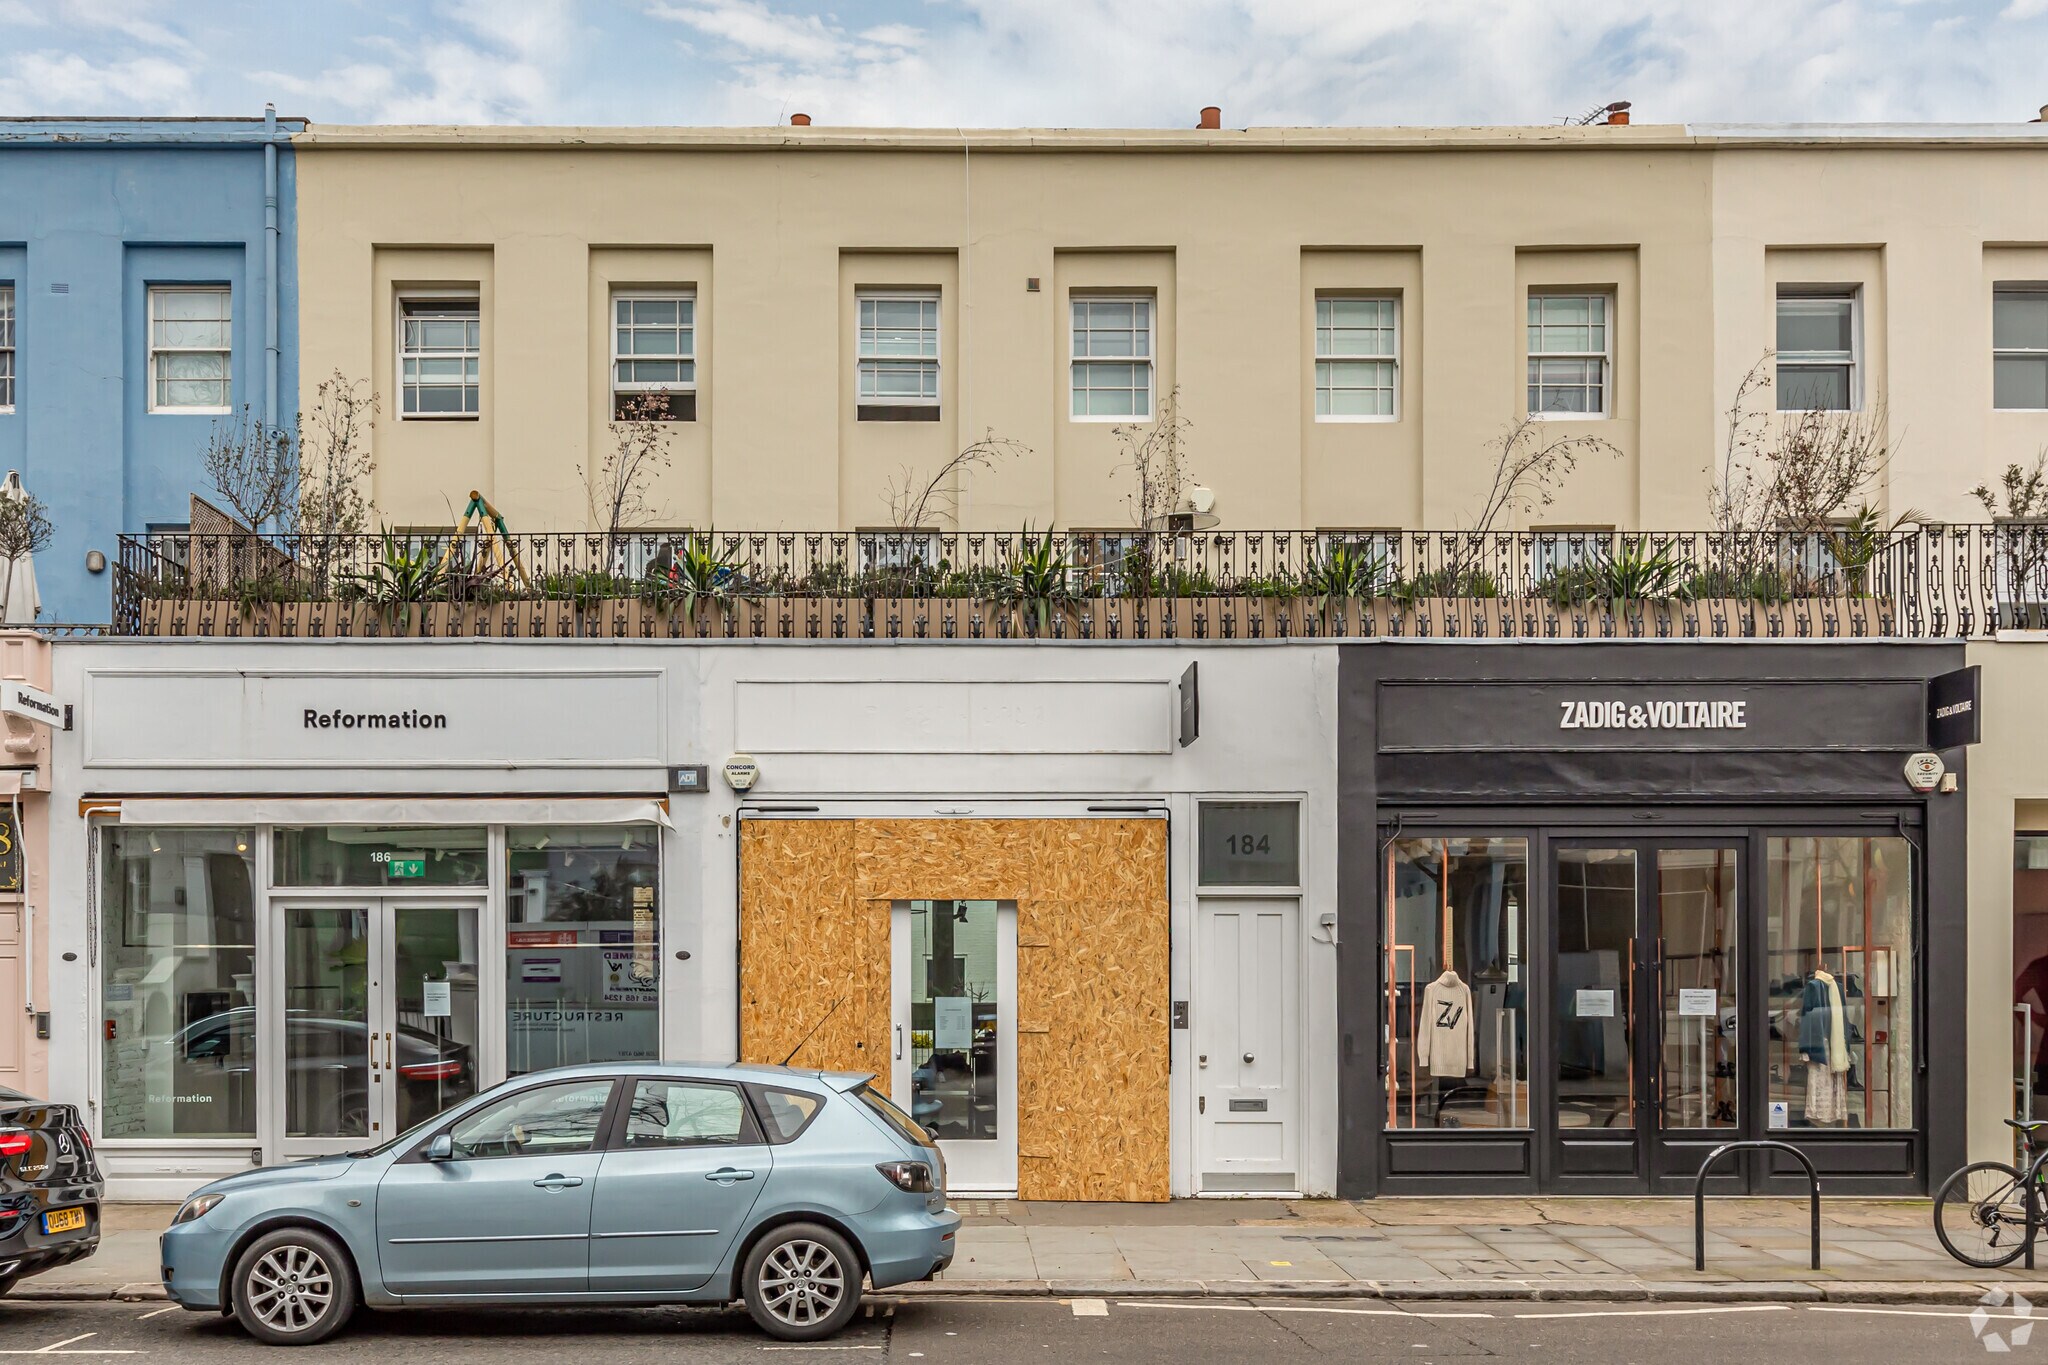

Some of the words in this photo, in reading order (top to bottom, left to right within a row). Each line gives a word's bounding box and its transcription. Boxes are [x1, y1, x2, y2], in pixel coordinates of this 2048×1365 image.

[18, 692, 59, 717] Reformation
[1936, 700, 1972, 719] ZADIG&VOLTAIRE
[303, 709, 447, 729] Reformation
[1560, 701, 1747, 729] ZADIG&VOLTAIRE
[679, 773, 696, 783] ADT
[1226, 834, 1270, 855] 184
[370, 852, 391, 862] 186
[148, 1094, 213, 1103] Reformation
